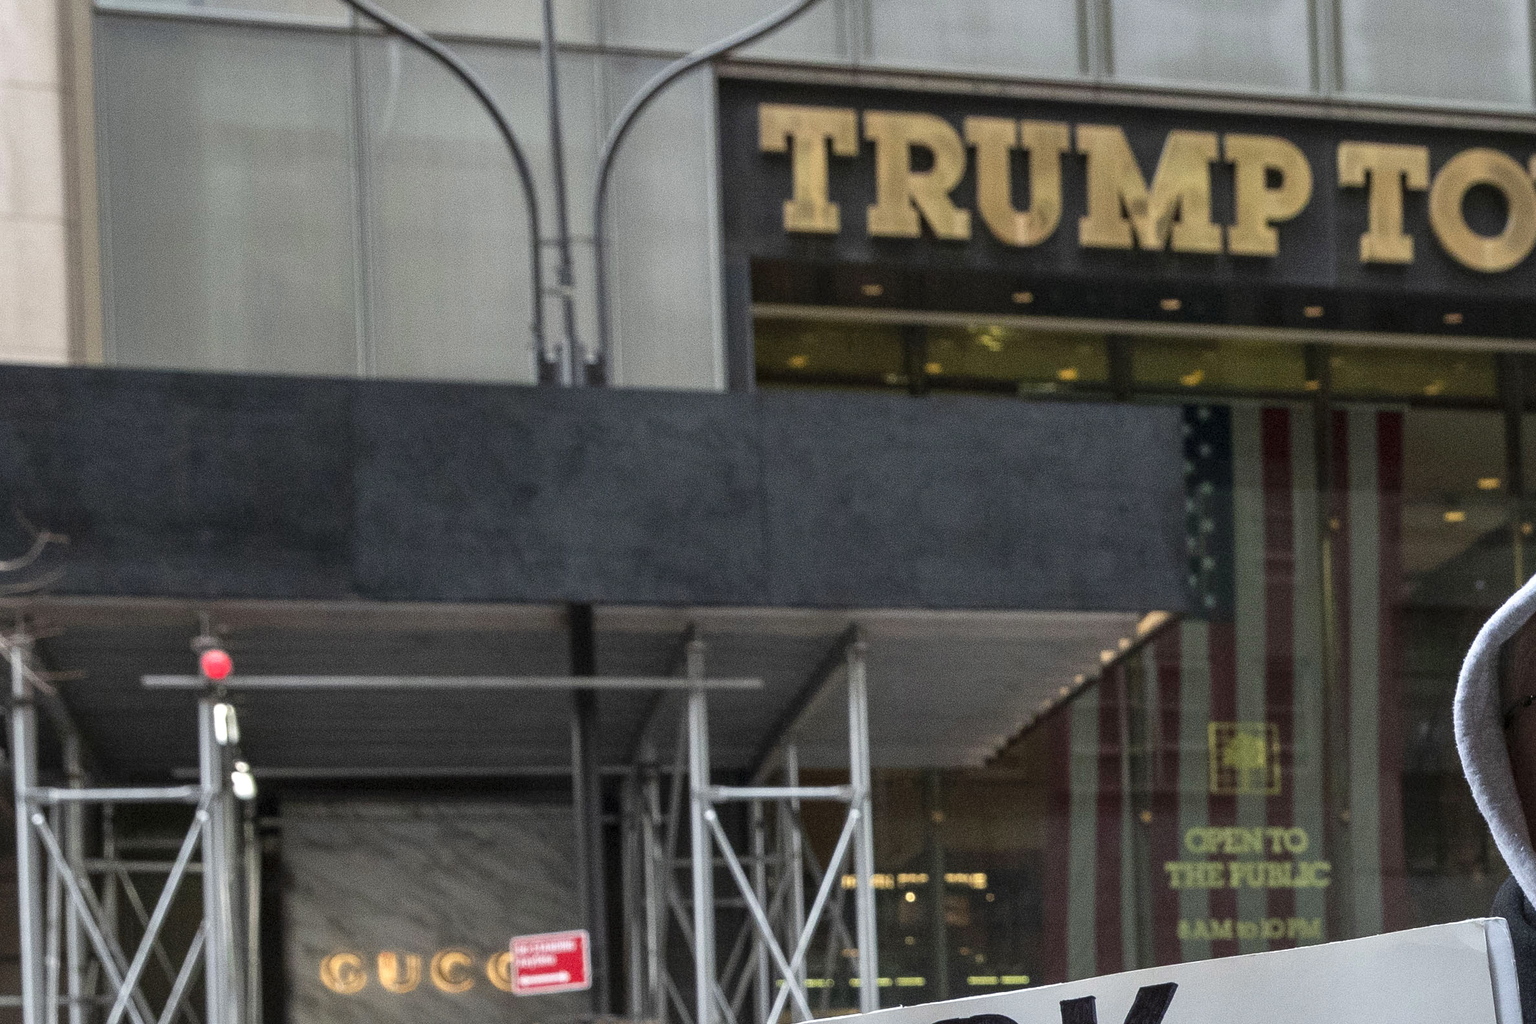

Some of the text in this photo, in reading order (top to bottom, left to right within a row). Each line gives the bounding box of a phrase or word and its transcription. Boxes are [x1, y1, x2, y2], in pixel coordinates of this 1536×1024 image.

[758, 104, 1313, 257] TRUMP
[1184, 827, 1308, 853] OPEN TO
[1164, 861, 1331, 888] THE PUBLIC
[319, 950, 512, 994] GUCC
